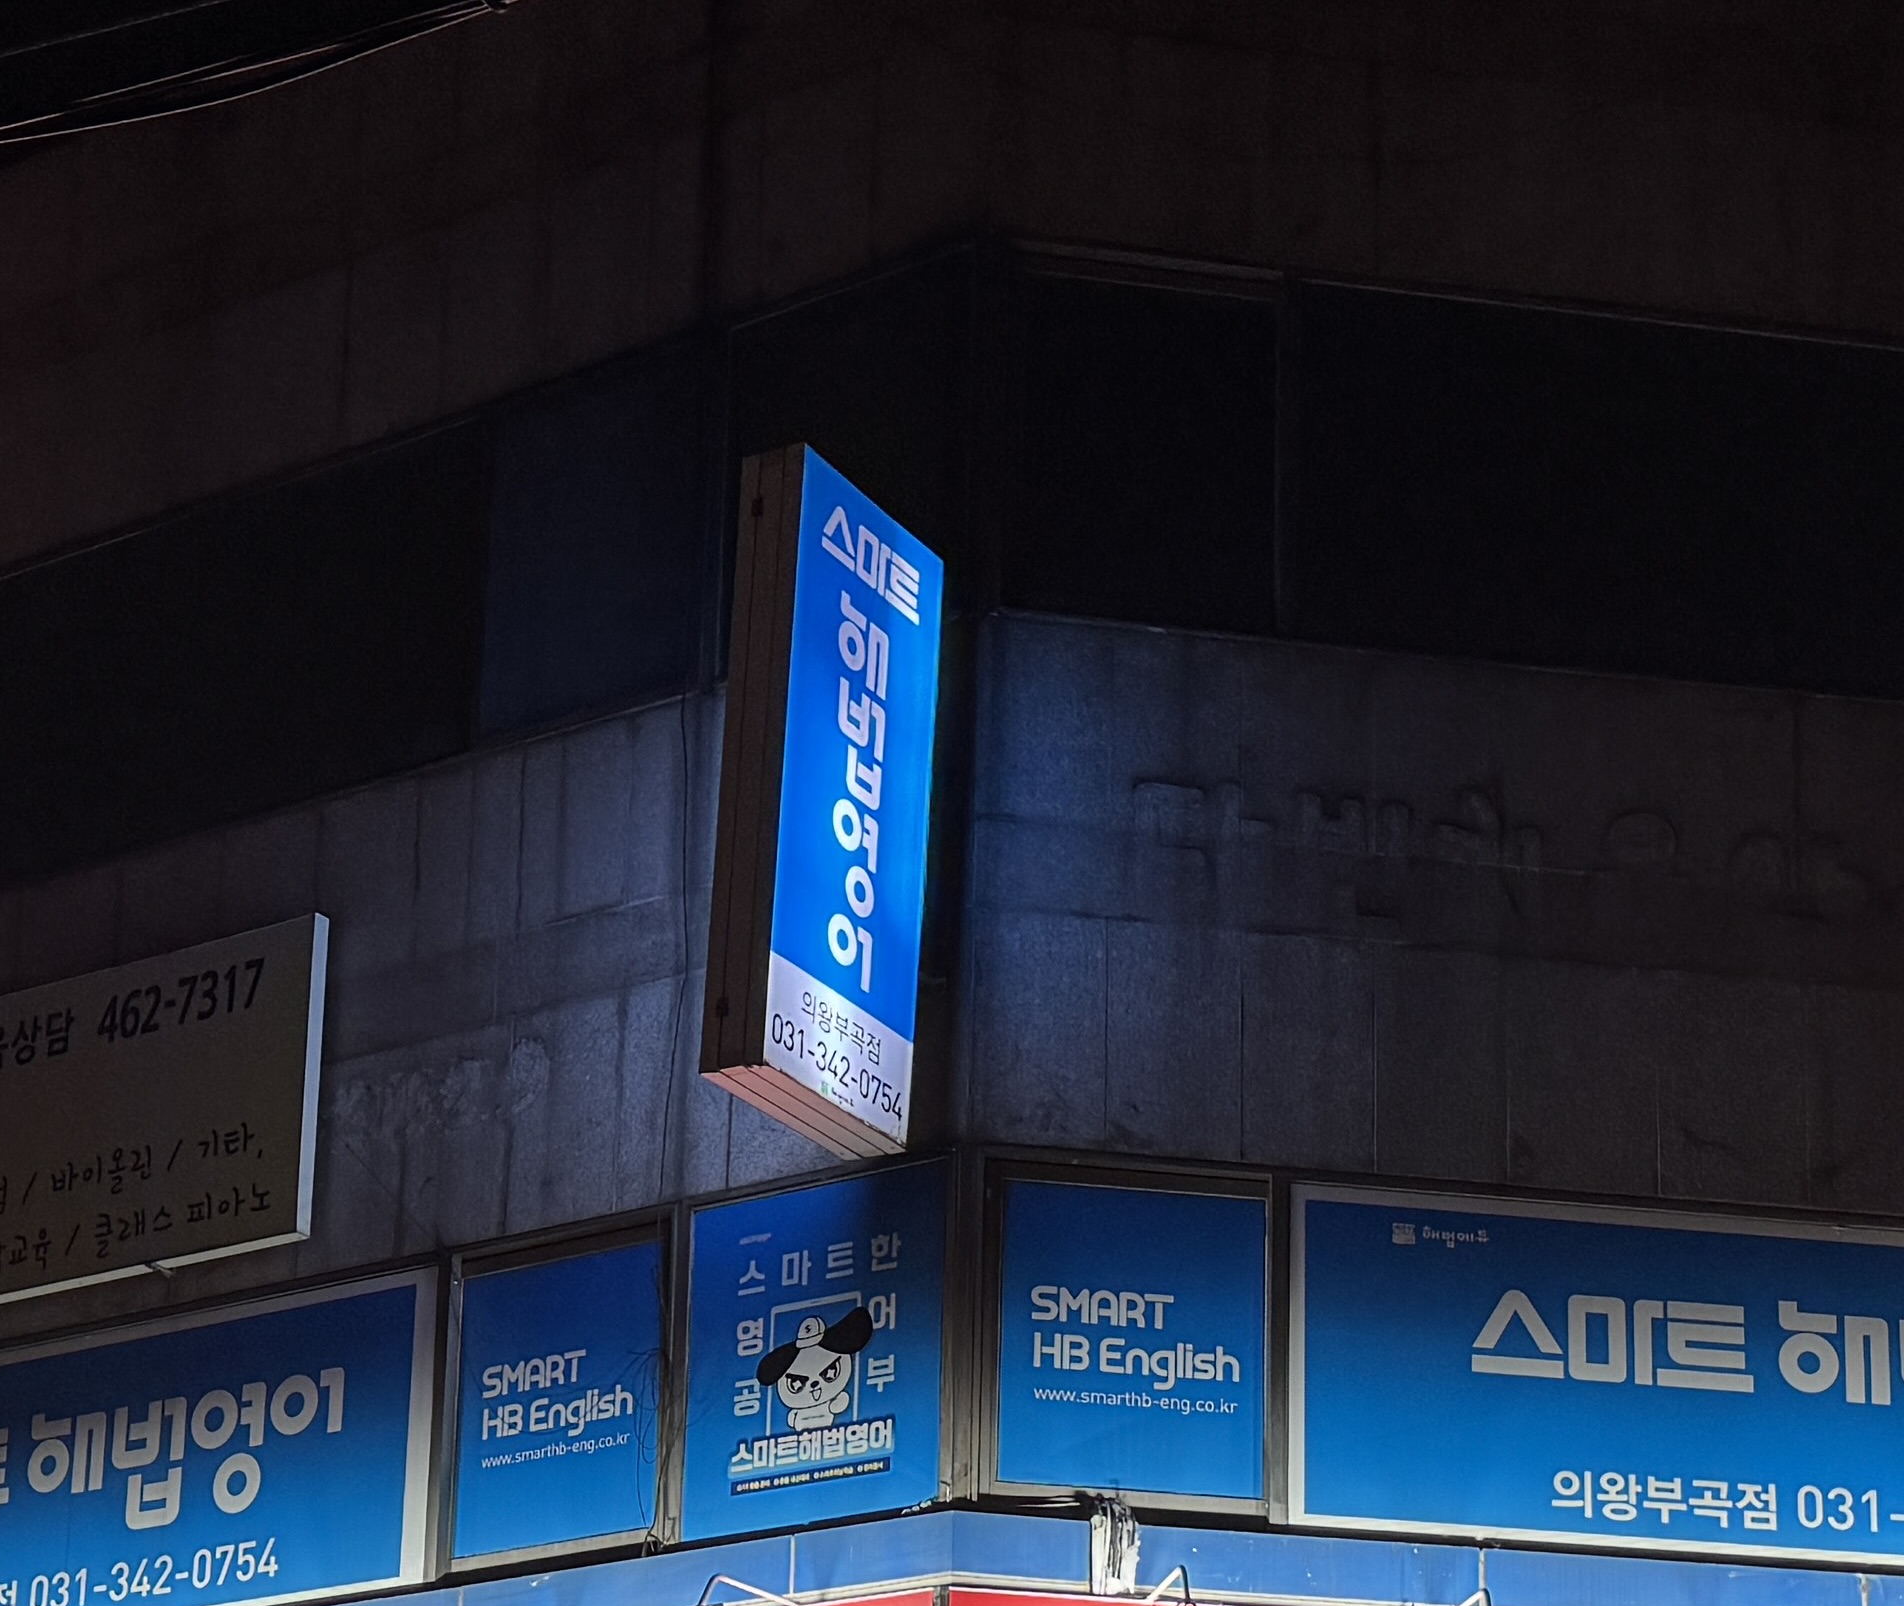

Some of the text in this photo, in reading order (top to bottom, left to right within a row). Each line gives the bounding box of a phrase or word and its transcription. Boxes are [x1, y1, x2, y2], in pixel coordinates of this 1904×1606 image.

[820, 505, 921, 626] 스마트
[827, 591, 890, 993] 해법영어
[98, 958, 265, 1044] 462-7317
[802, 991, 881, 1066] 의왕부곡점
[772, 1013, 903, 1121] 031-342-0754
[52, 1145, 152, 1193] 바이올린
[95, 1211, 173, 1259] 클래스
[187, 1184, 271, 1225] 피아노
[1030, 1285, 1174, 1330] SMART
[1032, 1332, 1240, 1389] HB English
[1470, 1289, 1754, 1394] 스마트
[482, 1349, 586, 1399] SMART
[1034, 1387, 1238, 1415] www.smarthb-eng.co.kr
[482, 1384, 633, 1441] HB English
[27, 1366, 345, 1531] 해법영어
[481, 1431, 630, 1468] www.smarthb-eng.co.kr
[730, 1418, 894, 1473] 스마트해법영어
[1552, 1469, 1778, 1532] 의왕부곡점
